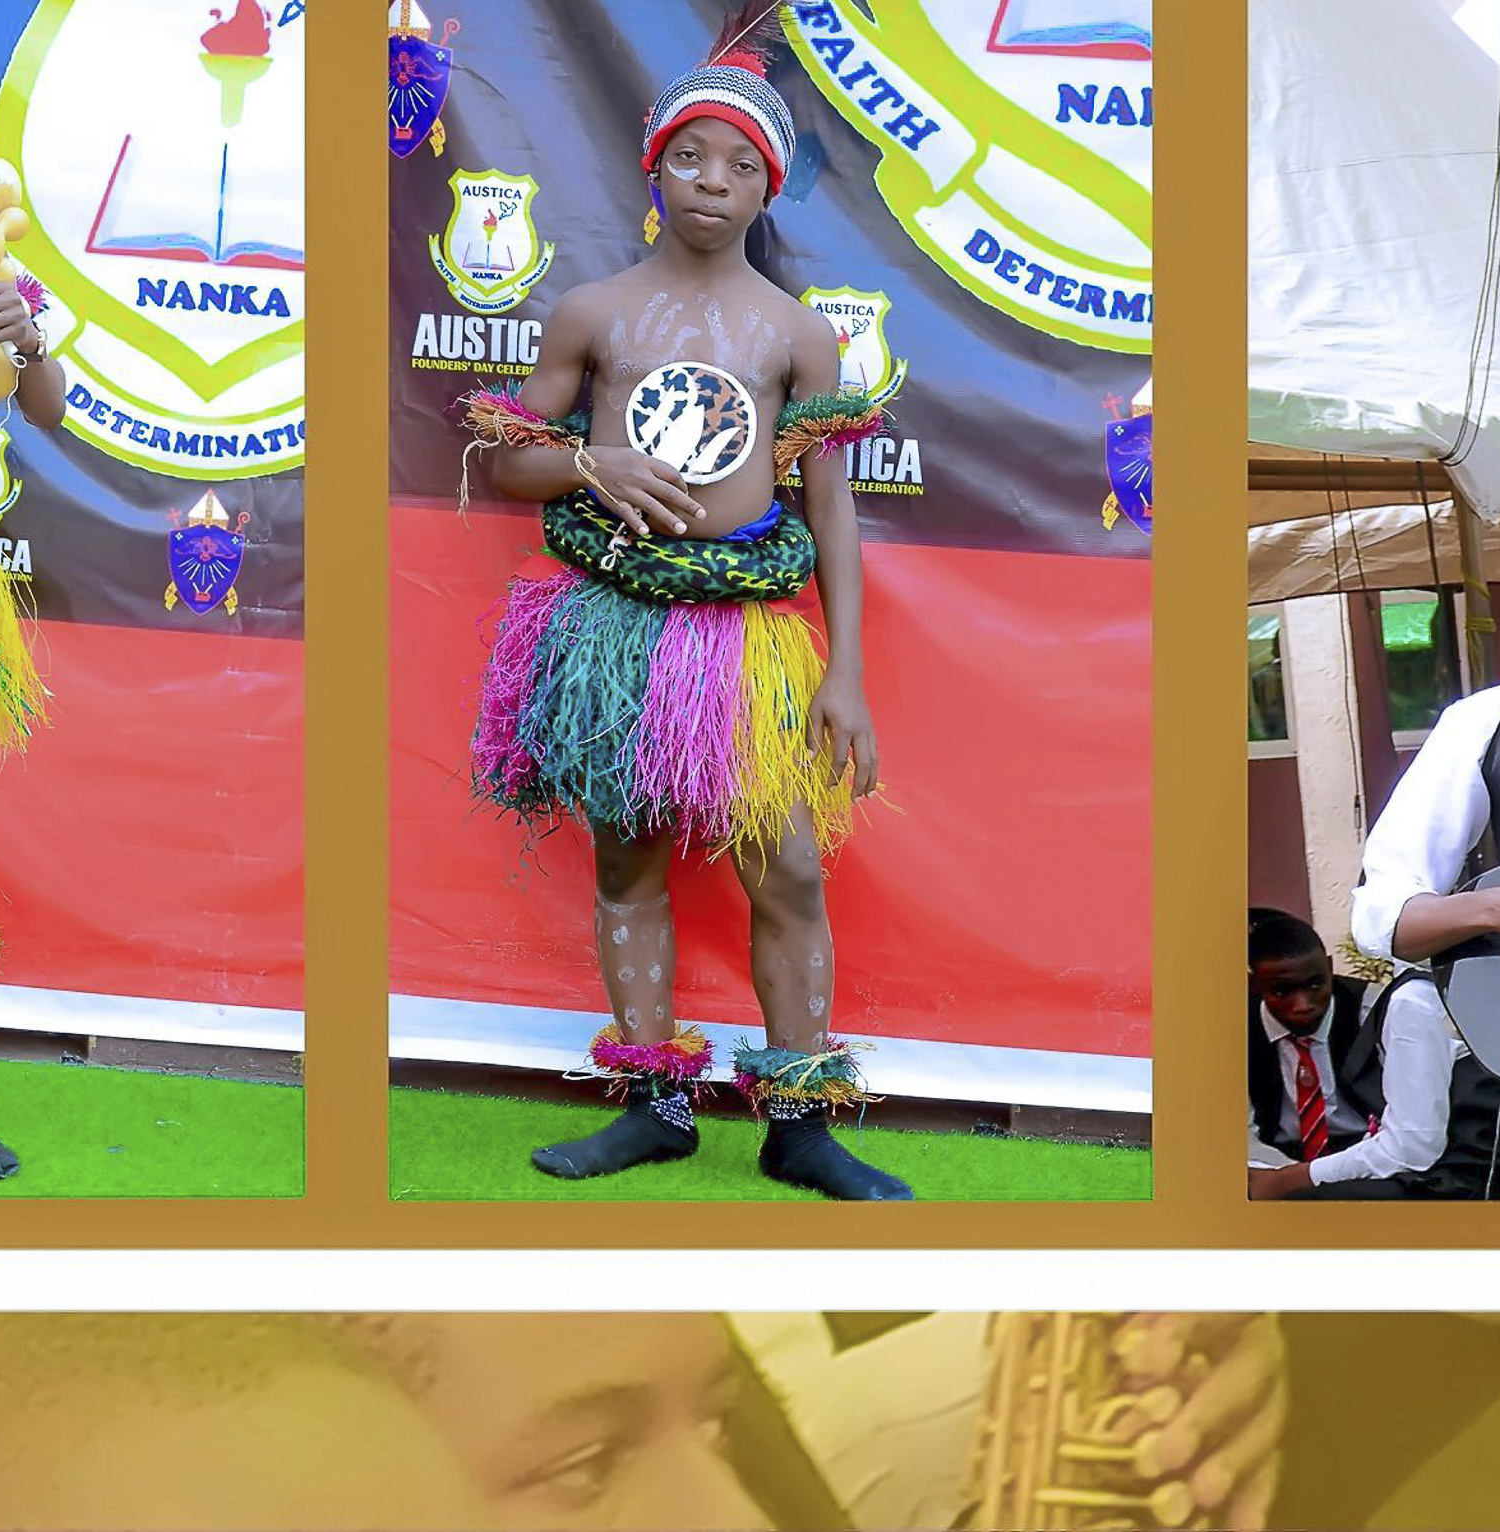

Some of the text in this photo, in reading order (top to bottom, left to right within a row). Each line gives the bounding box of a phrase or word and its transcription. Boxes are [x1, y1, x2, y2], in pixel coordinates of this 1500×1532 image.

[796, 0, 942, 151] FAITH
[462, 186, 522, 200] AUSTICA
[435, 258, 457, 283] FAITH
[471, 271, 503, 281] NANKA
[136, 277, 291, 317] NANKA
[815, 303, 875, 316] AUSTICA
[411, 357, 471, 371] FOUNDERS'
[473, 362, 494, 373] DAY
[848, 479, 924, 496] CELEBRATION
